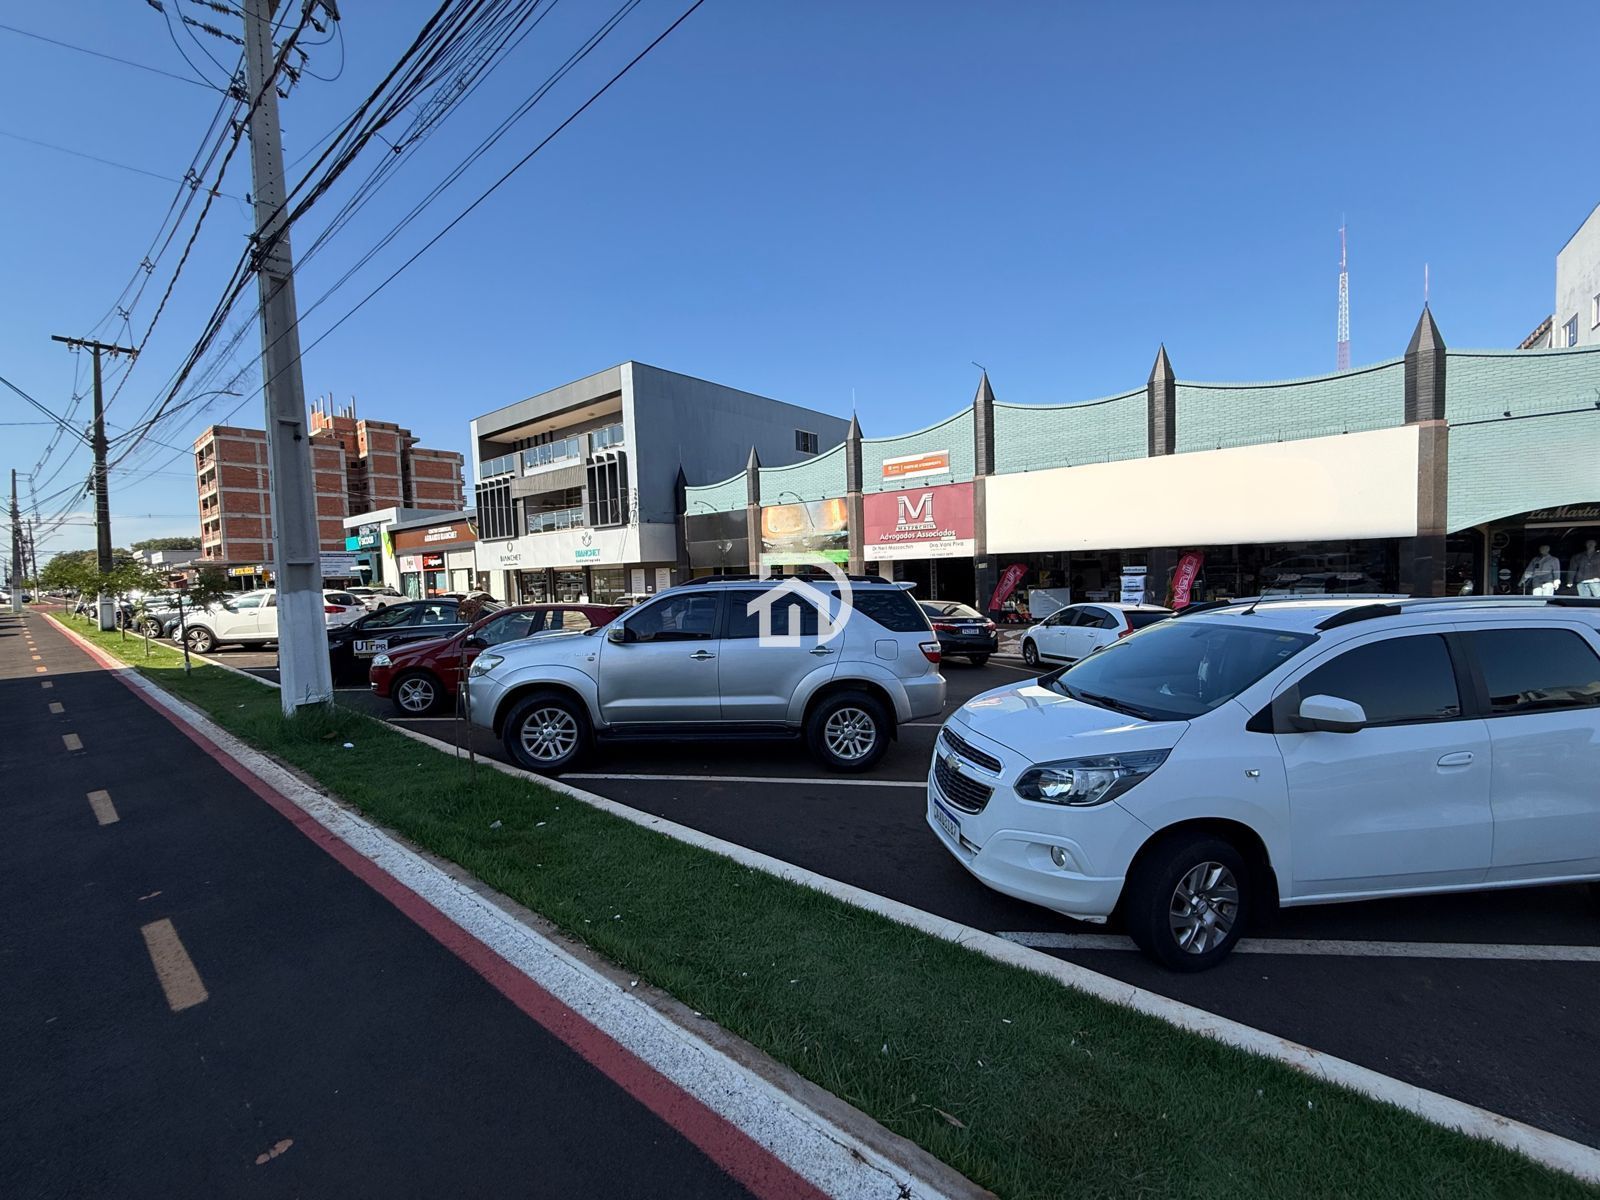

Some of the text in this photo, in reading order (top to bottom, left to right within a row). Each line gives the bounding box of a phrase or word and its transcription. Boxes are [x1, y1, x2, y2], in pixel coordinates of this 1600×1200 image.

[880, 528, 956, 541] Advogados Associados
[500, 554, 521, 562] BIANCHET
